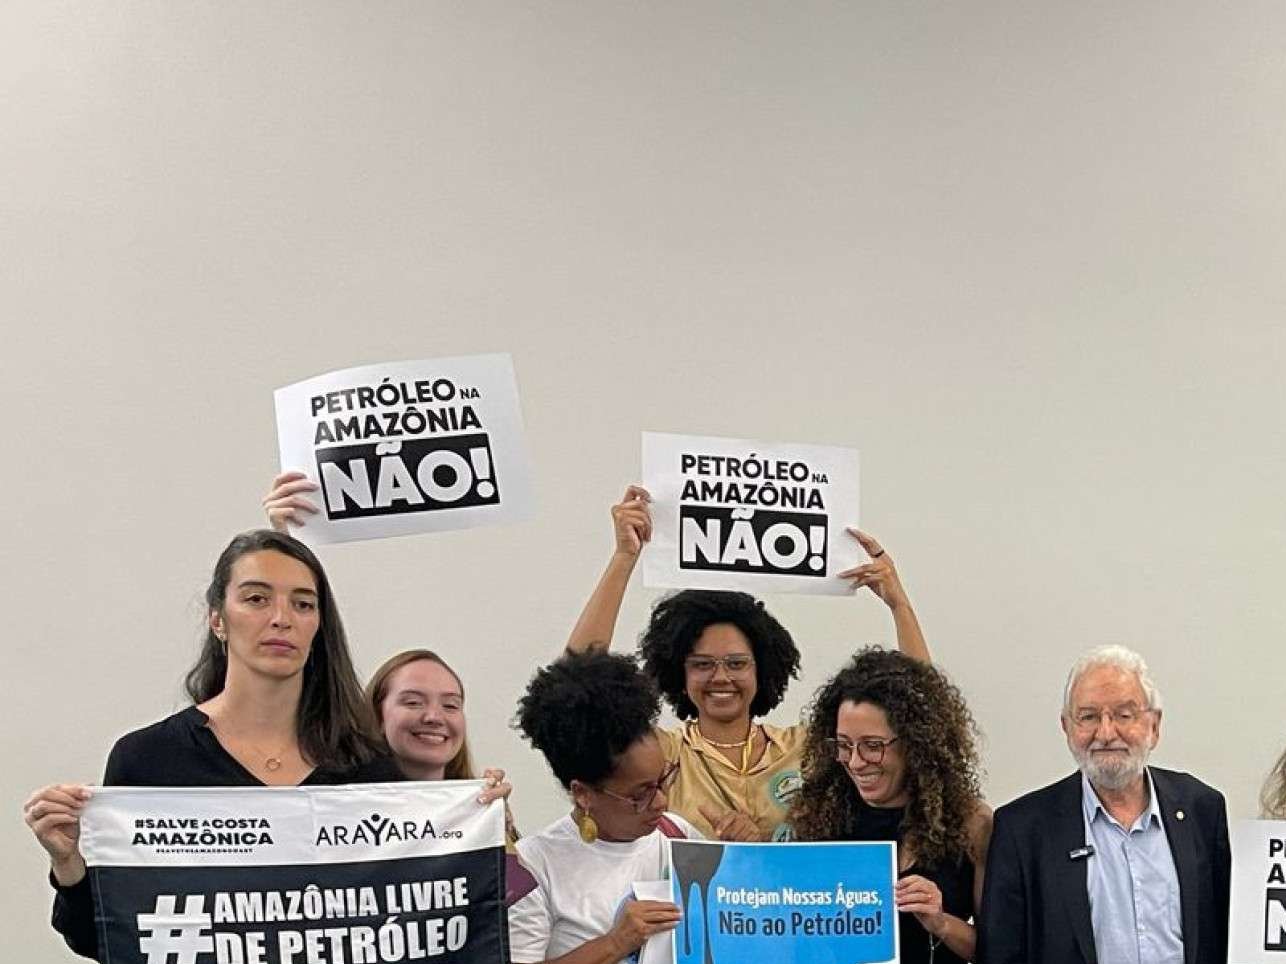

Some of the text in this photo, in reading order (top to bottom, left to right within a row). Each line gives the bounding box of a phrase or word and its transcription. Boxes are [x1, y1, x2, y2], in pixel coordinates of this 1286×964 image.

[310, 377, 481, 417] PETRÓLEO NA
[314, 405, 483, 445] AMAZÔNIA
[320, 440, 495, 512] NÃO!
[681, 453, 829, 484] PETRÓLEO NA
[681, 480, 825, 510] AMAZÔNIA
[682, 508, 826, 571] NÃO!
[132, 829, 274, 845] AMAZÔNICA
[135, 819, 199, 829] #SALVE
[211, 819, 271, 829] COSTA
[214, 884, 380, 923] AMAZÔNIA
[385, 877, 469, 914] LIVRE
[716, 881, 883, 908] Protejam Nossas Águas,
[719, 910, 882, 935] Não ao Petróleo!
